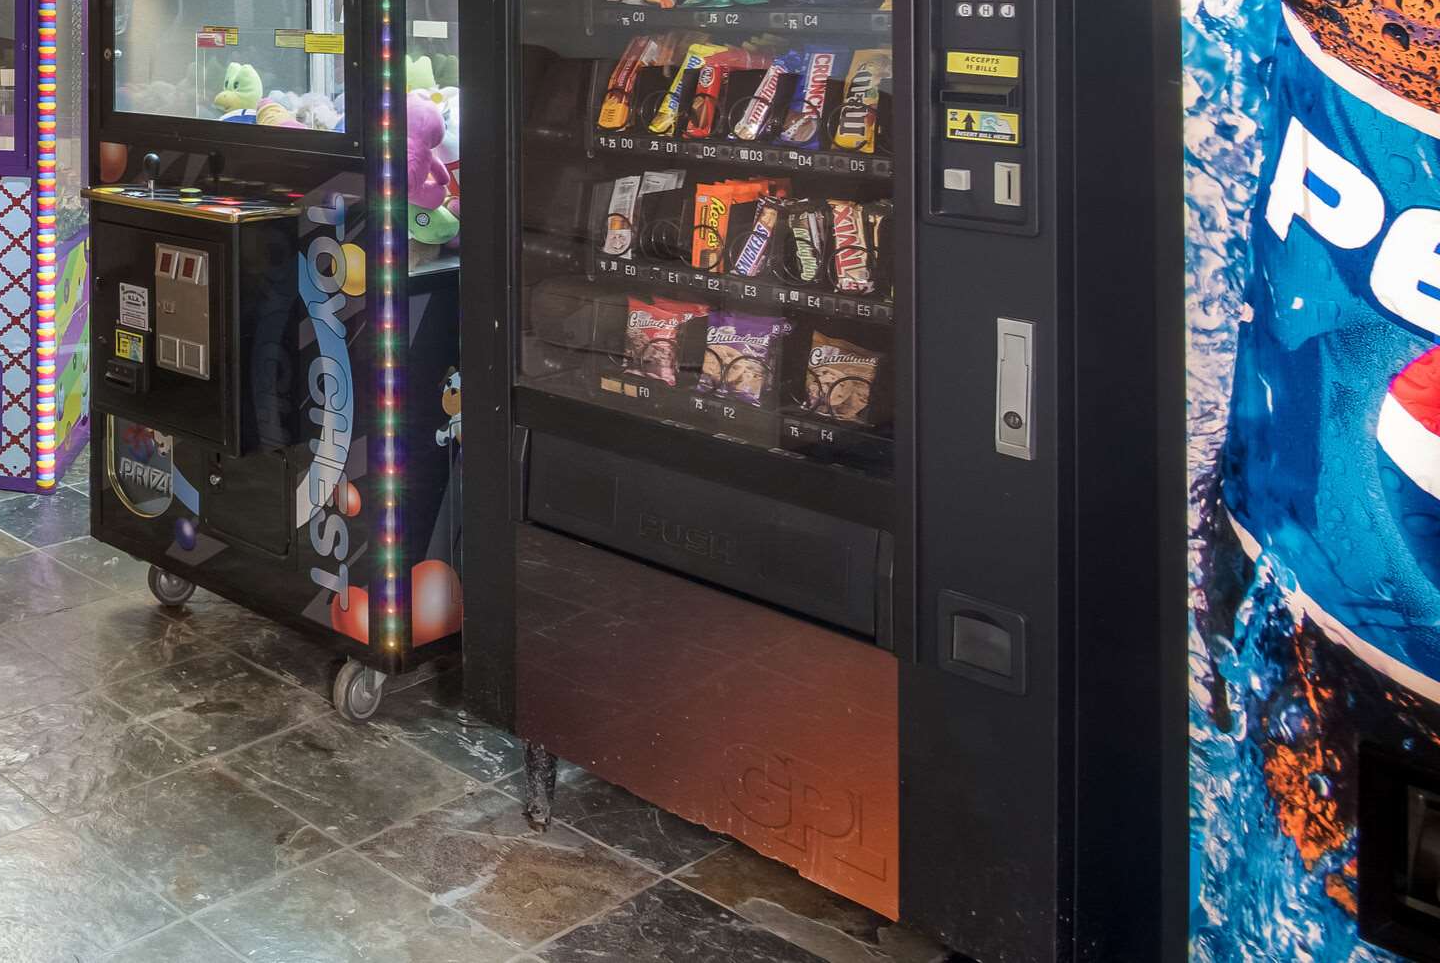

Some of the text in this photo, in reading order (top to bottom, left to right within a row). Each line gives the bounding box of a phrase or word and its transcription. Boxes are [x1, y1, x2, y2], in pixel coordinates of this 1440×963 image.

[632, 11, 645, 22] C0
[725, 13, 740, 25] C2
[804, 15, 818, 26] C4
[964, 55, 1000, 65] ACCEPTS
[976, 65, 998, 73] BILLS
[621, 138, 633, 149] D0
[666, 142, 678, 153] D1
[703, 146, 716, 158] D2
[749, 150, 763, 161] D3
[798, 155, 812, 167] D4
[850, 160, 865, 172] D5
[833, 204, 866, 278] TWIX
[735, 224, 769, 276] SNICKERS
[307, 194, 347, 339] TOY
[625, 265, 636, 276] E0
[668, 272, 679, 283] E1
[707, 279, 720, 290] E2
[744, 285, 757, 297] E3
[807, 296, 821, 308] E4
[857, 304, 871, 317] E5
[639, 386, 650, 398] F0
[723, 406, 736, 419] F2
[821, 429, 833, 441] F4
[308, 355, 350, 612] CHEST
